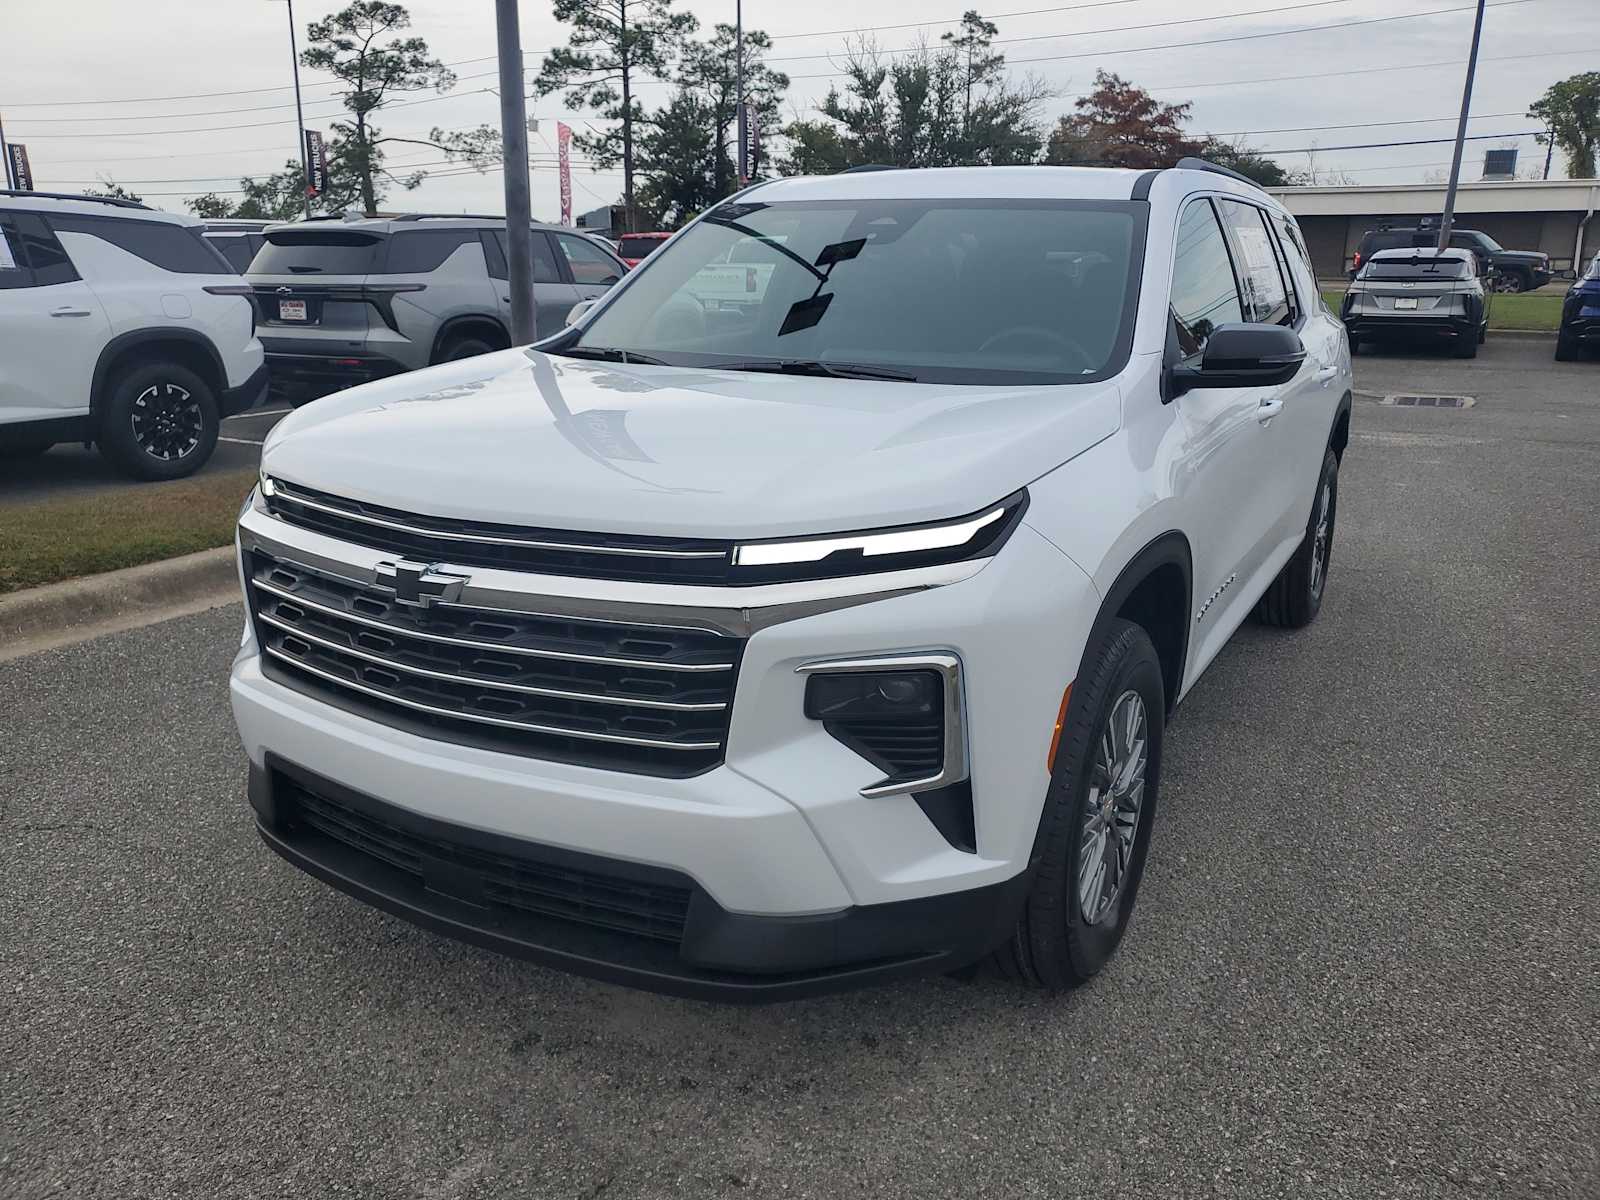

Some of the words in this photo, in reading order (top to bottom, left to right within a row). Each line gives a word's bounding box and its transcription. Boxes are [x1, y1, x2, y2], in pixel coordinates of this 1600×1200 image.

[746, 107, 755, 152] TRUCKS
[15, 146, 25, 177] TRUCKS
[310, 134, 321, 169] TRUCKS
[746, 153, 755, 178] NEW
[19, 177, 27, 191] EW
[314, 170, 322, 191] NEW
